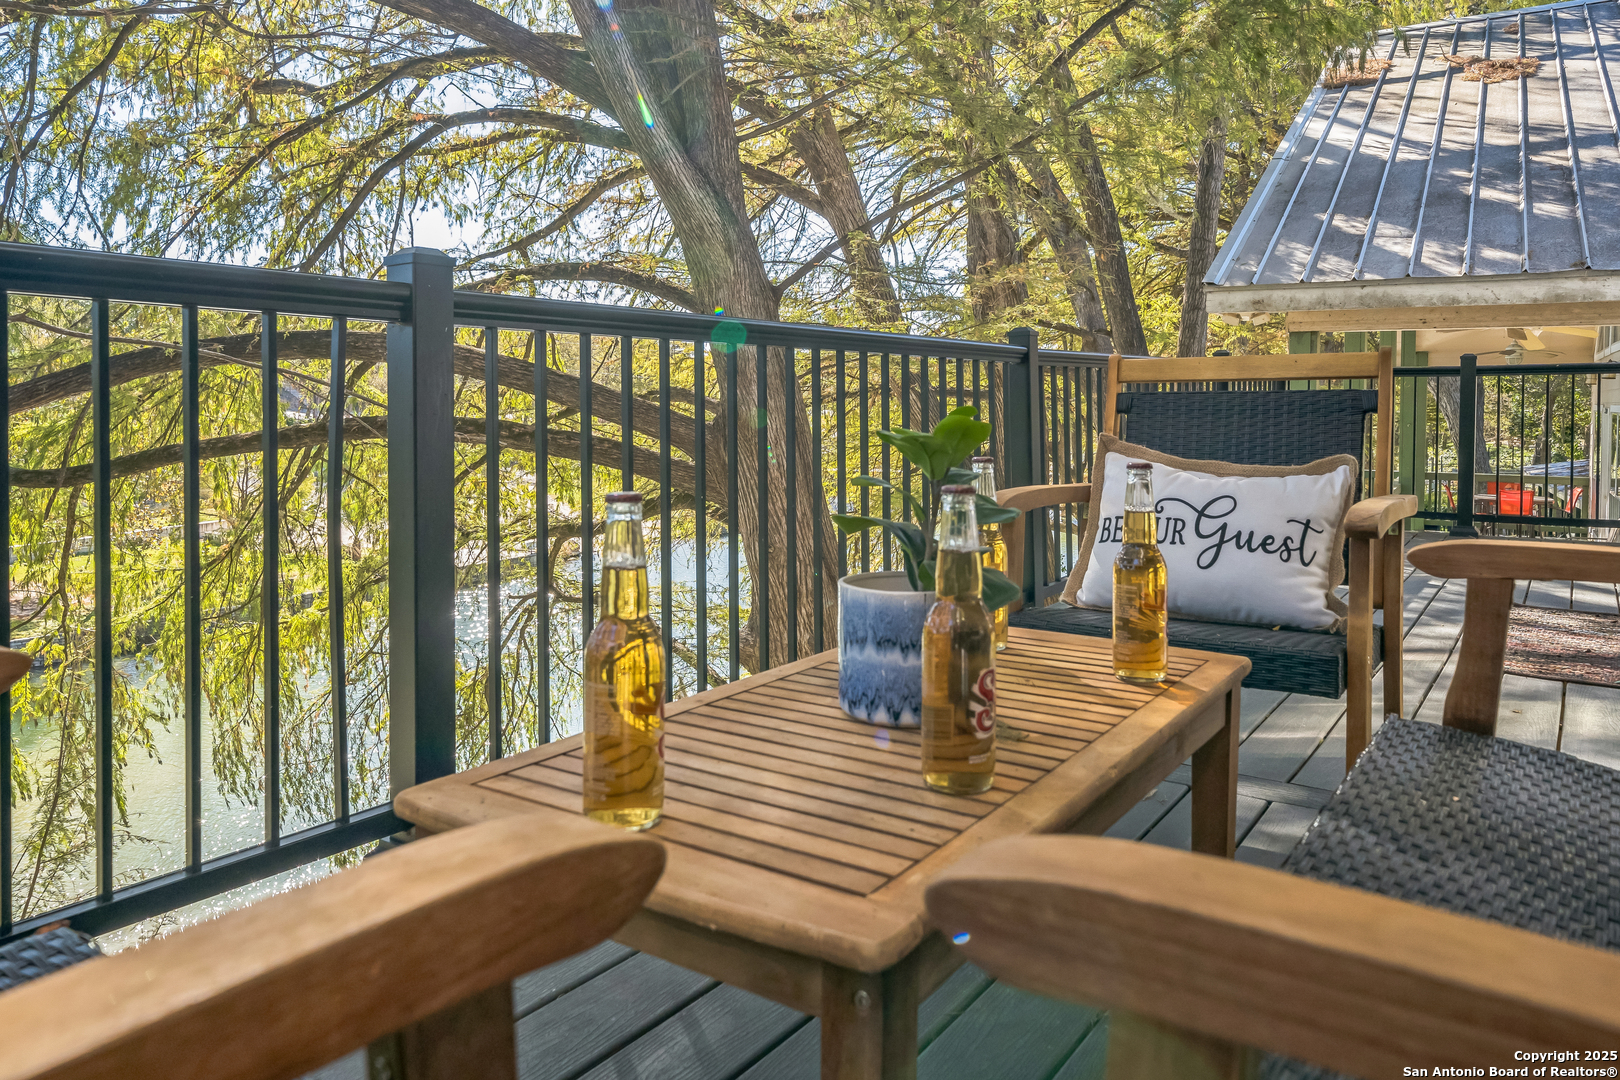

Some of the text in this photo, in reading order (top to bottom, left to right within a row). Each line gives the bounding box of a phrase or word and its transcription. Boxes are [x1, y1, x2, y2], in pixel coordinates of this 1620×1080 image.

[1099, 495, 1324, 570] BE UR Guest
